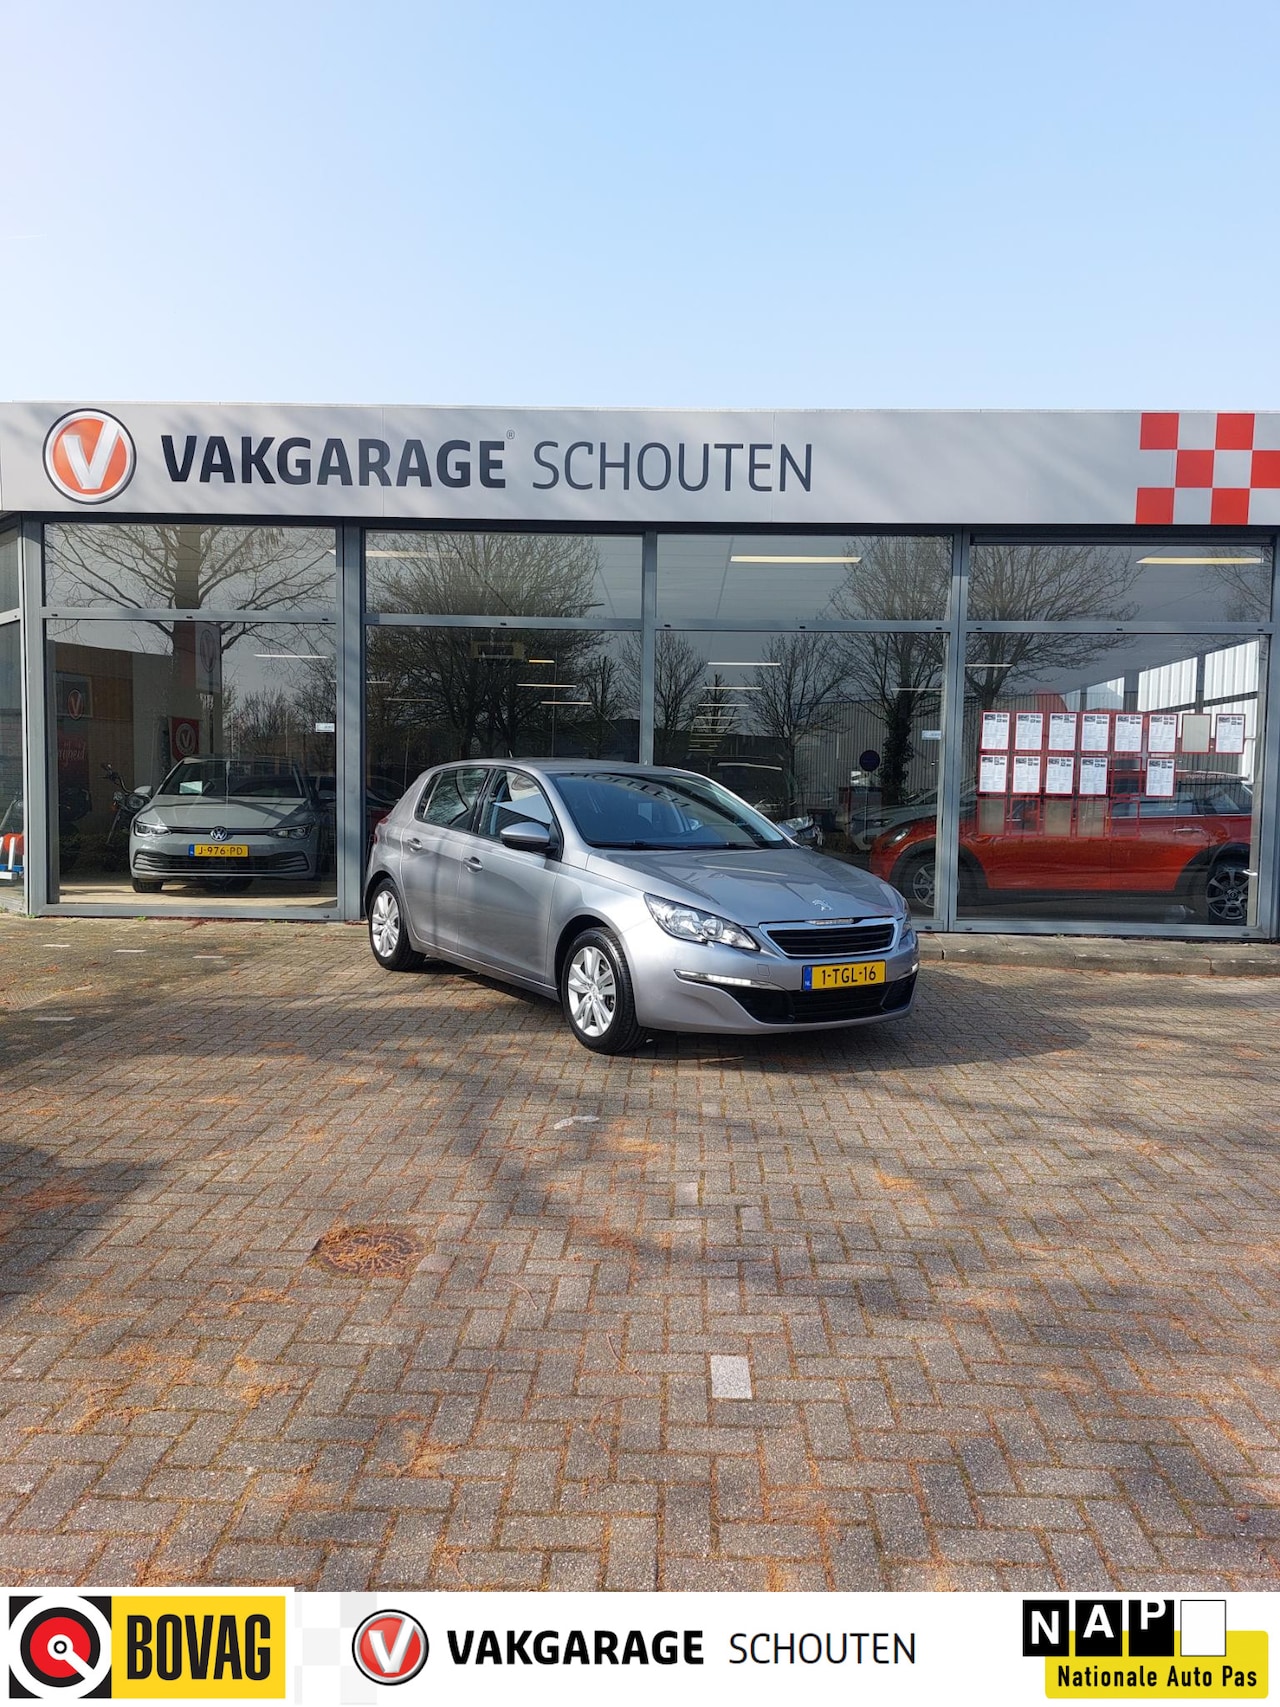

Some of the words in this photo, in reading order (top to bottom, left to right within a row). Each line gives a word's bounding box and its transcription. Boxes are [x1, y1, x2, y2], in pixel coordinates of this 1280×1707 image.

[161, 434, 507, 489] VAKGARAGE
[532, 441, 813, 492] SCHOUTEN
[198, 846, 243, 856] J-976-PD
[822, 965, 877, 985] 1-TGL-16
